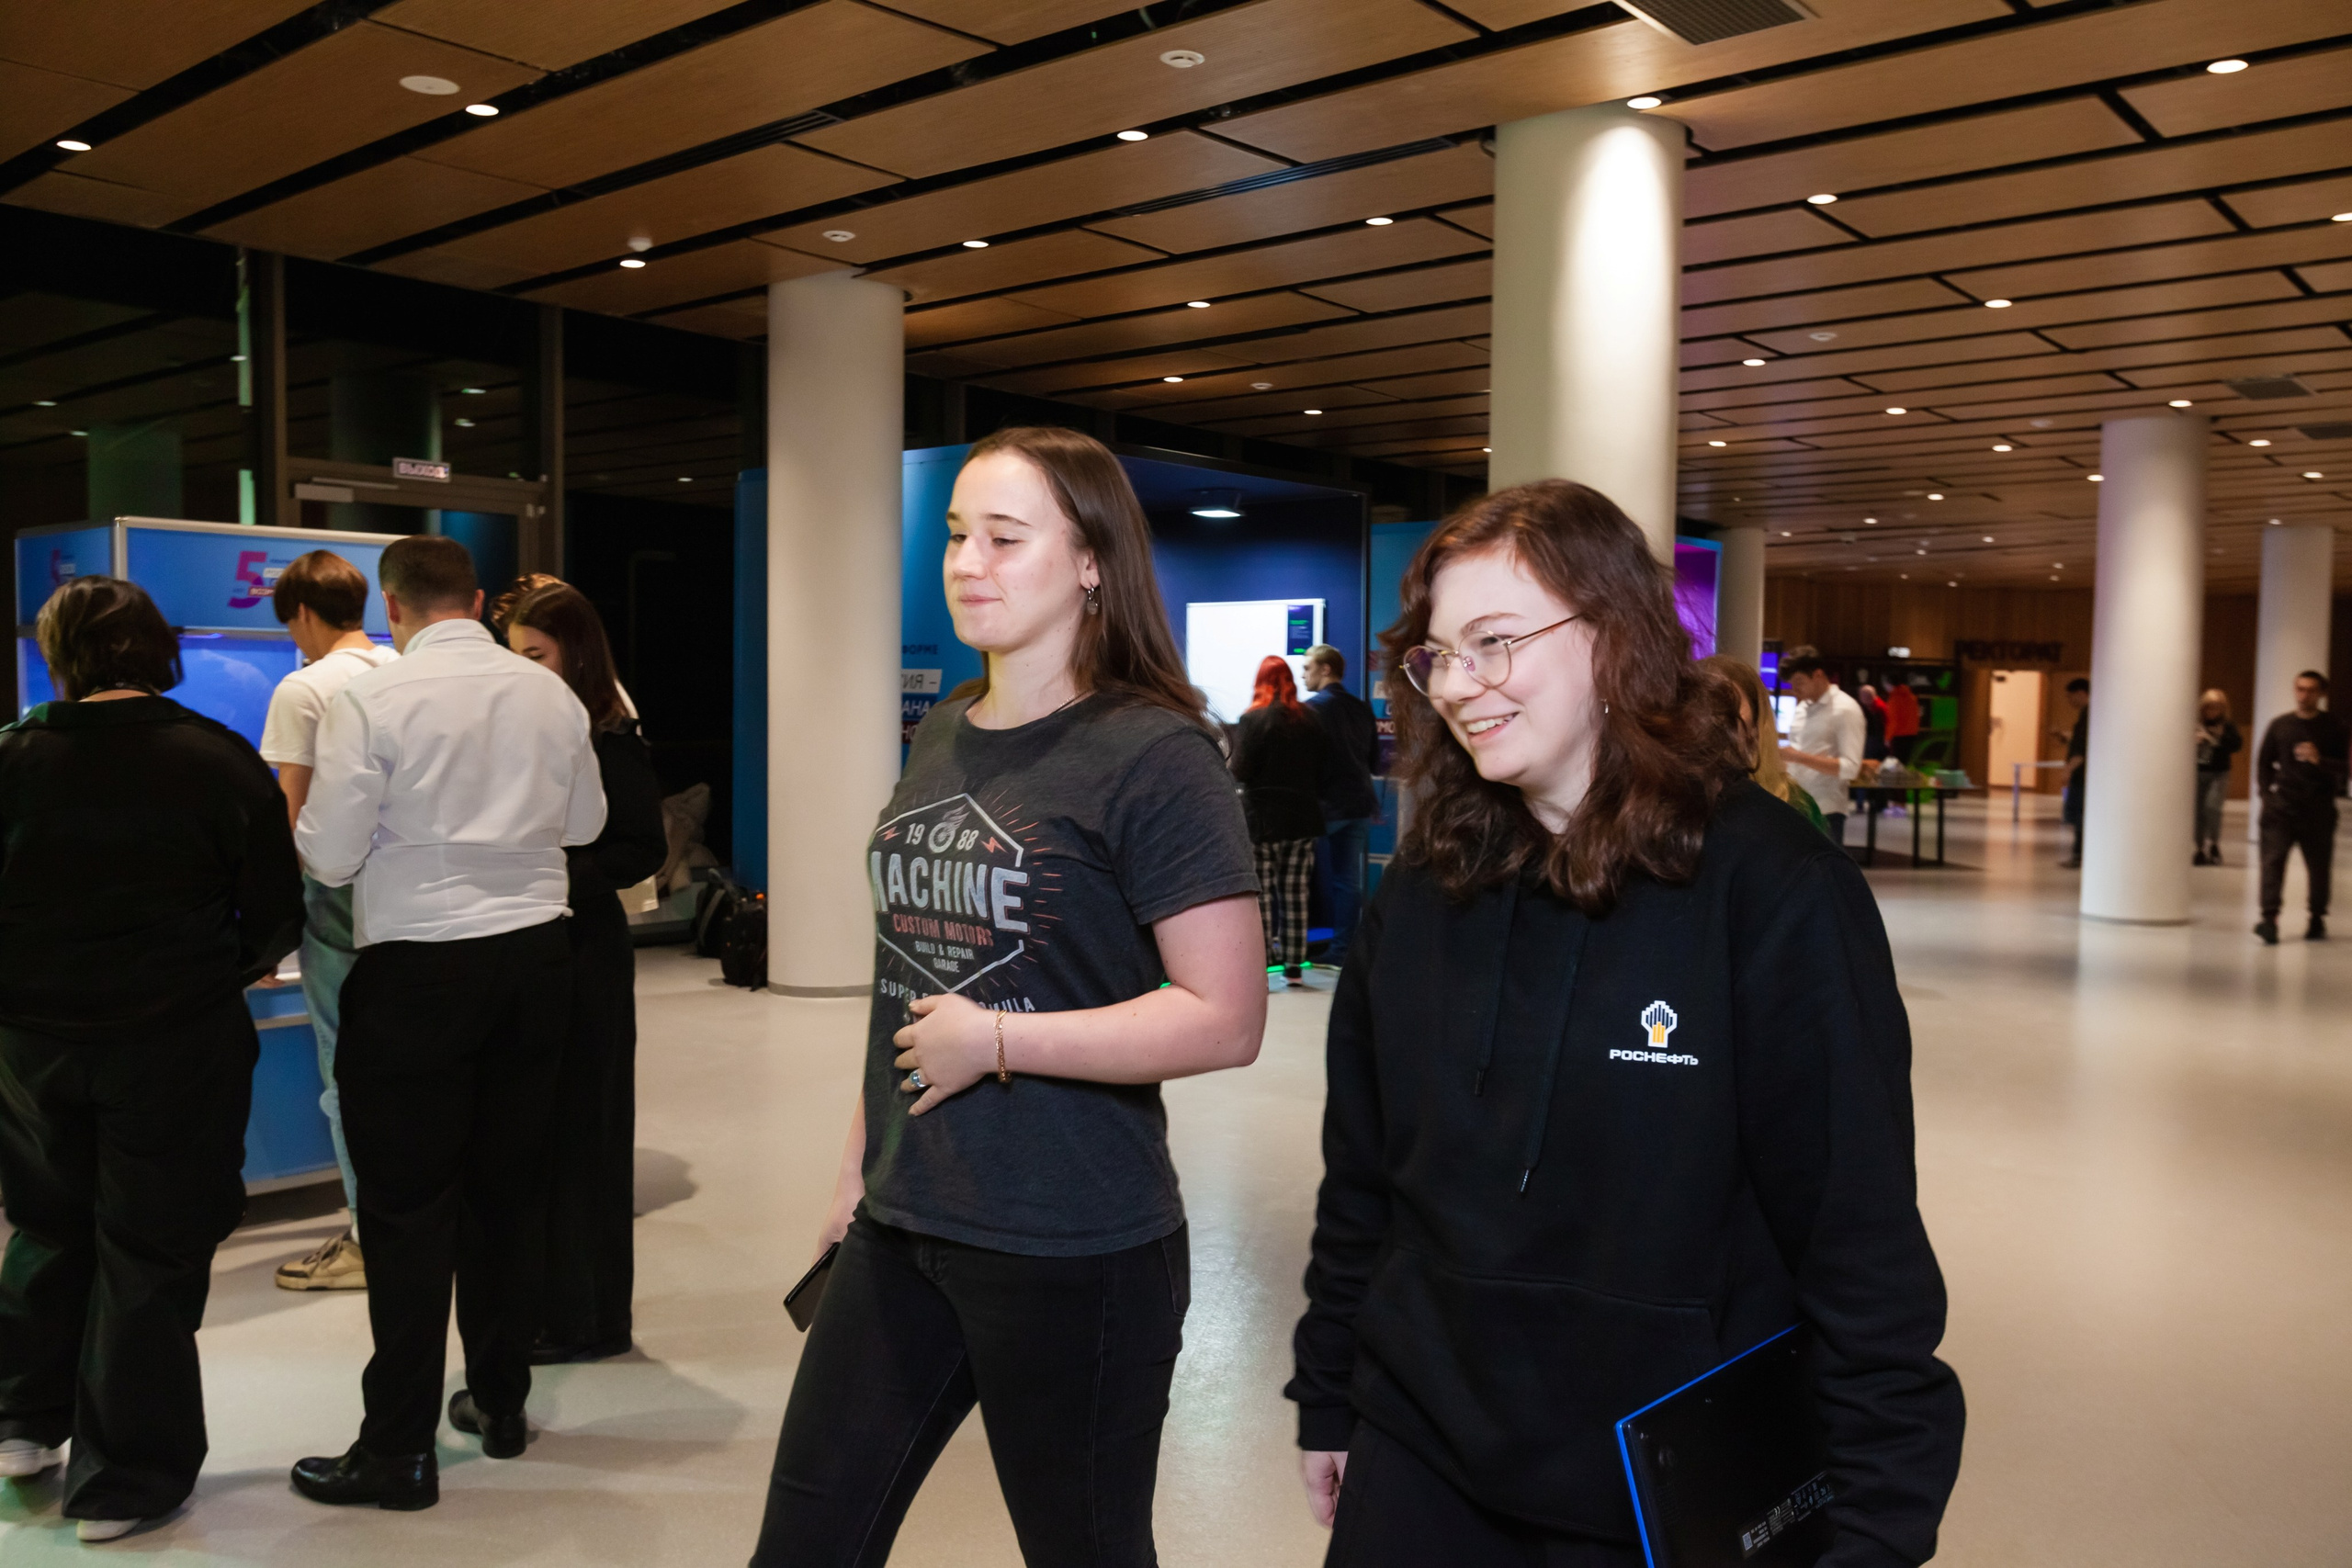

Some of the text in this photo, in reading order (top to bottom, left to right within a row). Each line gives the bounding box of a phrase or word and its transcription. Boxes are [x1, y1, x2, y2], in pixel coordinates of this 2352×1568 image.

[906, 823, 979, 851] 19 88
[893, 913, 994, 947] CUSTOM MOTORS
[915, 941, 974, 960] BUILD & REPAIR
[933, 957, 960, 973] GARAGE
[1610, 1049, 1699, 1066] РОСНЕФТЬ
